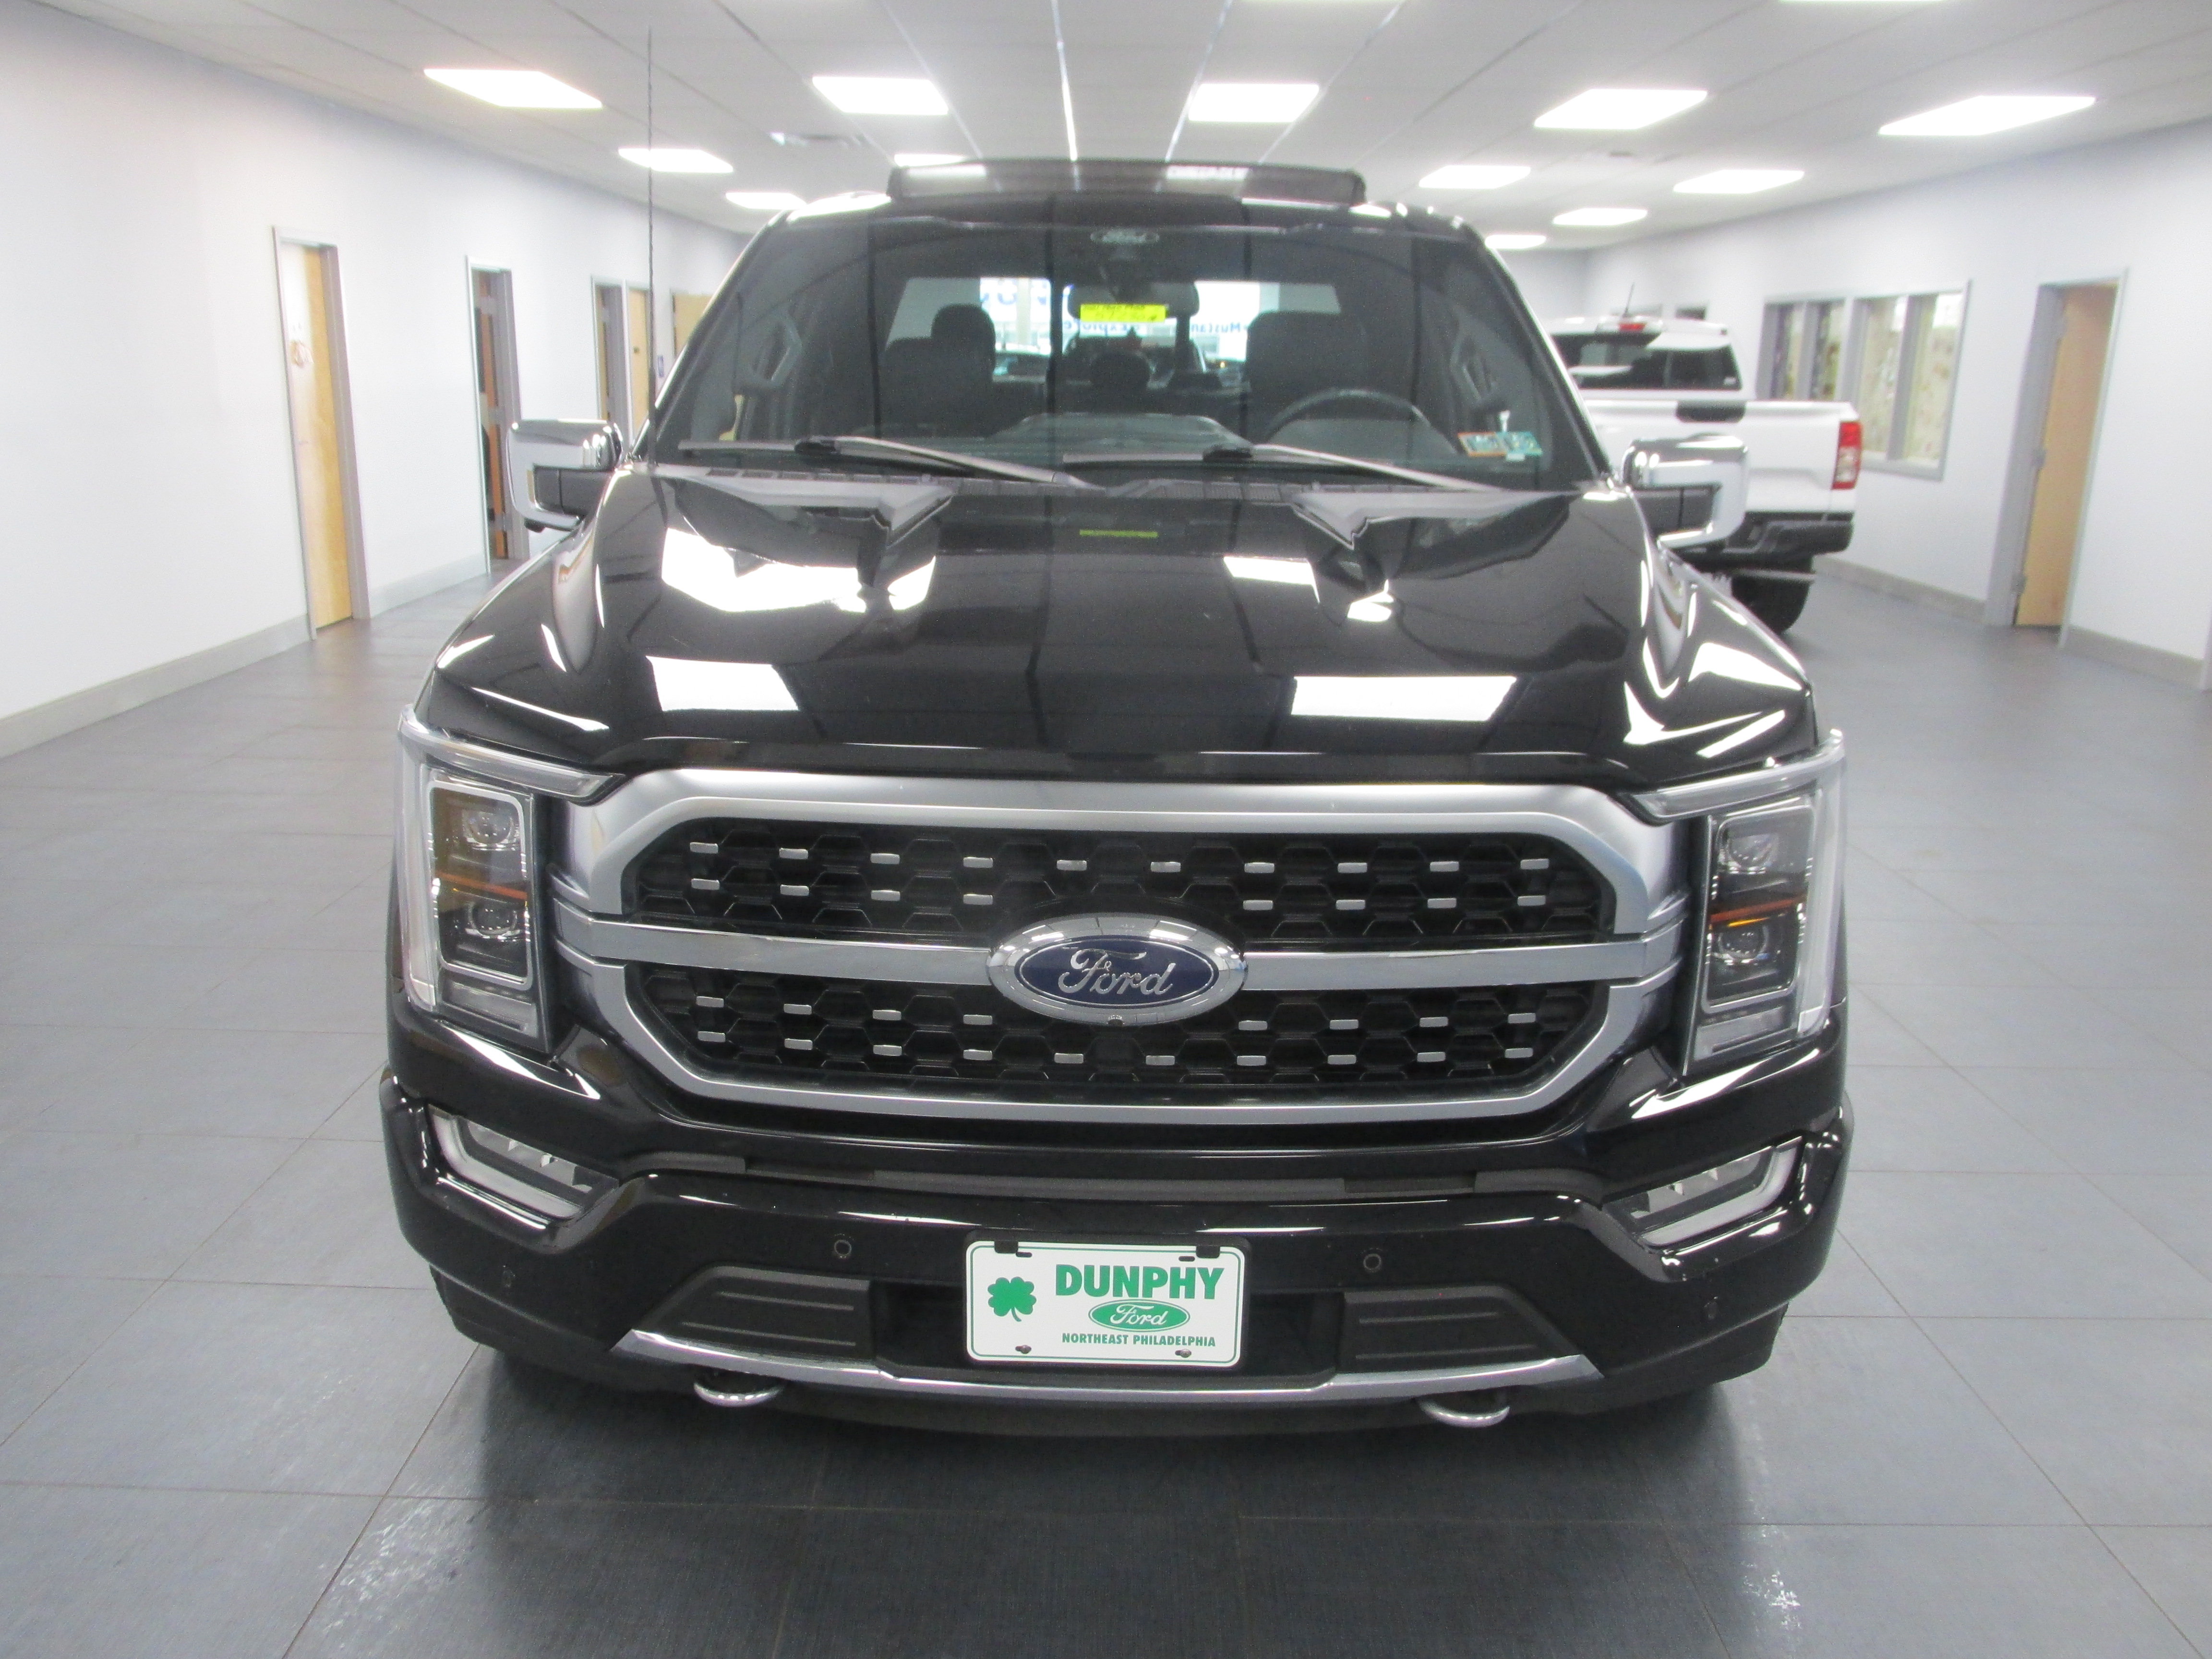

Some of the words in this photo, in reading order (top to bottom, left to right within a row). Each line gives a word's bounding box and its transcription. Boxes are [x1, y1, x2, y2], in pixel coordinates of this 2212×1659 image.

[1058, 948, 1176, 995] Ford
[1056, 1264, 1225, 1299] DUNPHY
[1110, 1304, 1169, 1325] Ford
[1062, 1332, 1129, 1345] NORTHEAST
[1133, 1334, 1216, 1347] PHILADELPHIA
